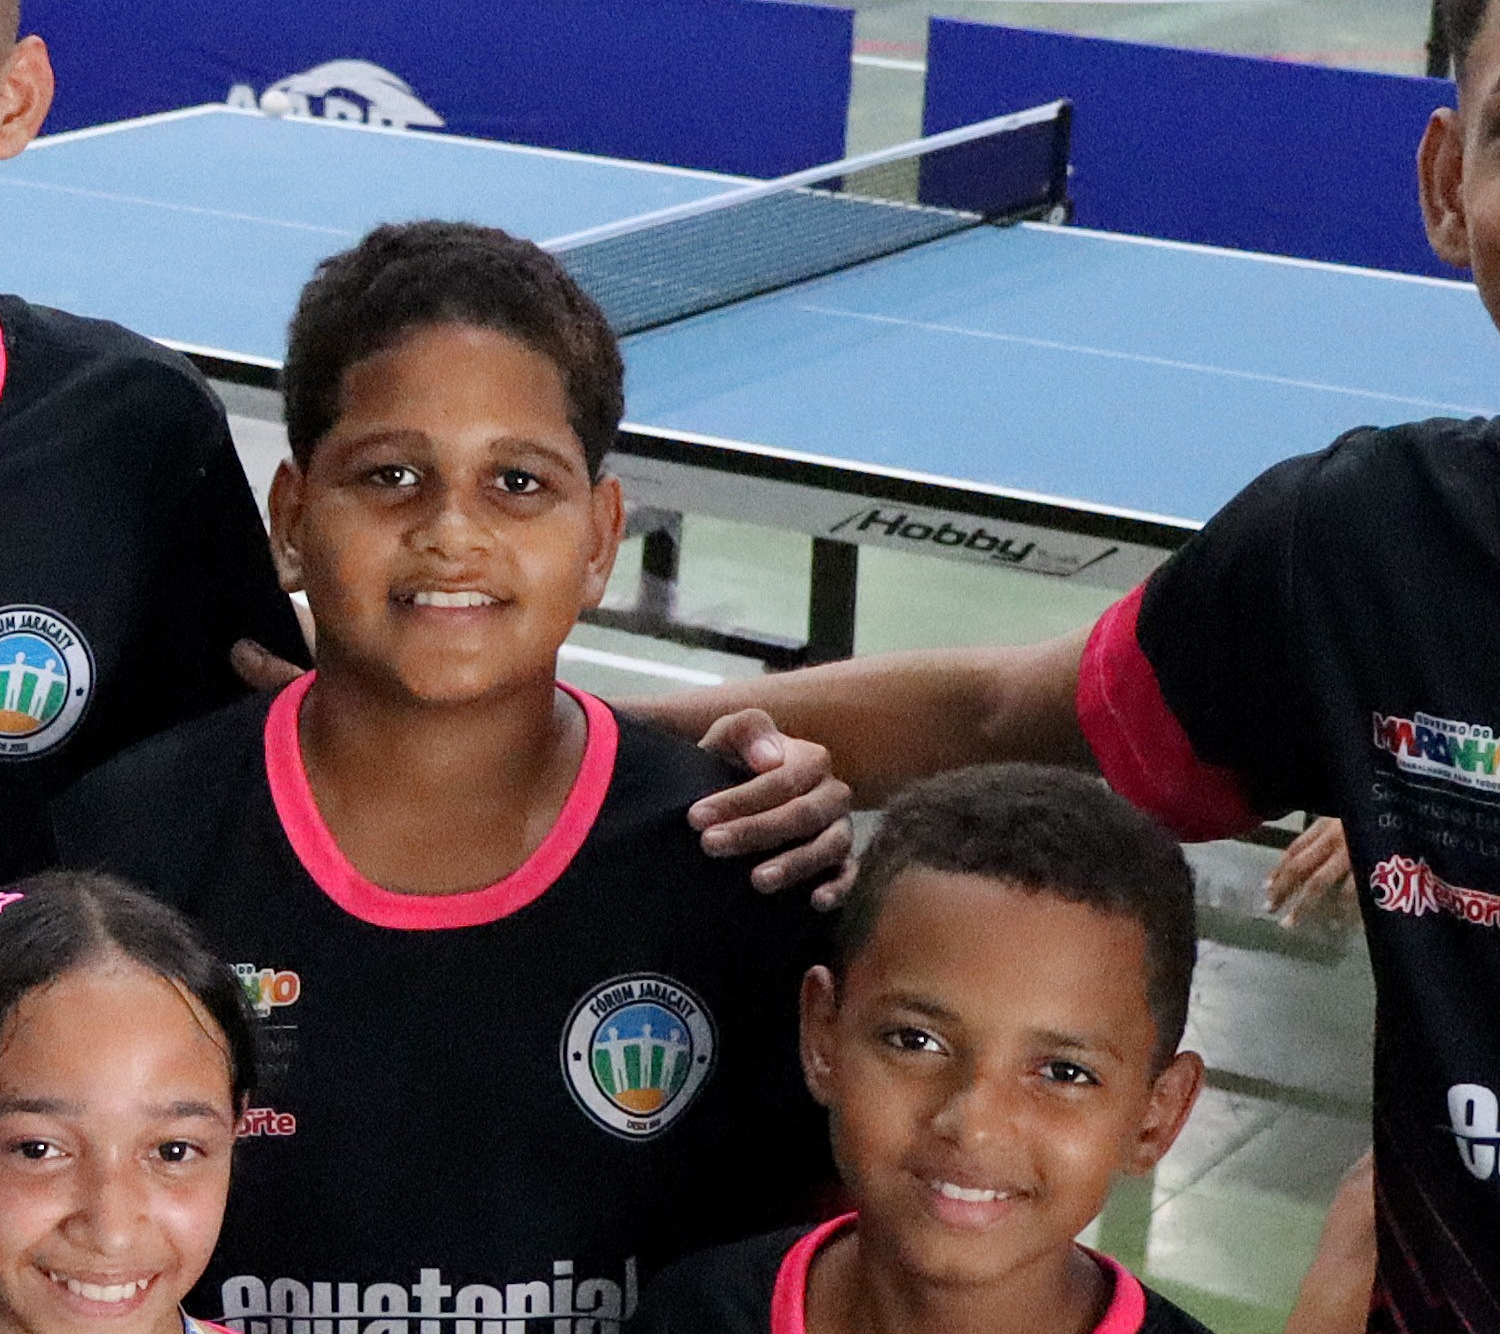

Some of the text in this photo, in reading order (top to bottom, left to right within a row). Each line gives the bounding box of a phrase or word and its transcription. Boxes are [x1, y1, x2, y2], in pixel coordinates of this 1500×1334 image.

[858, 509, 1038, 564] Hobby
[18, 614, 76, 651] JARACATY
[589, 983, 636, 1019] FÓRUM
